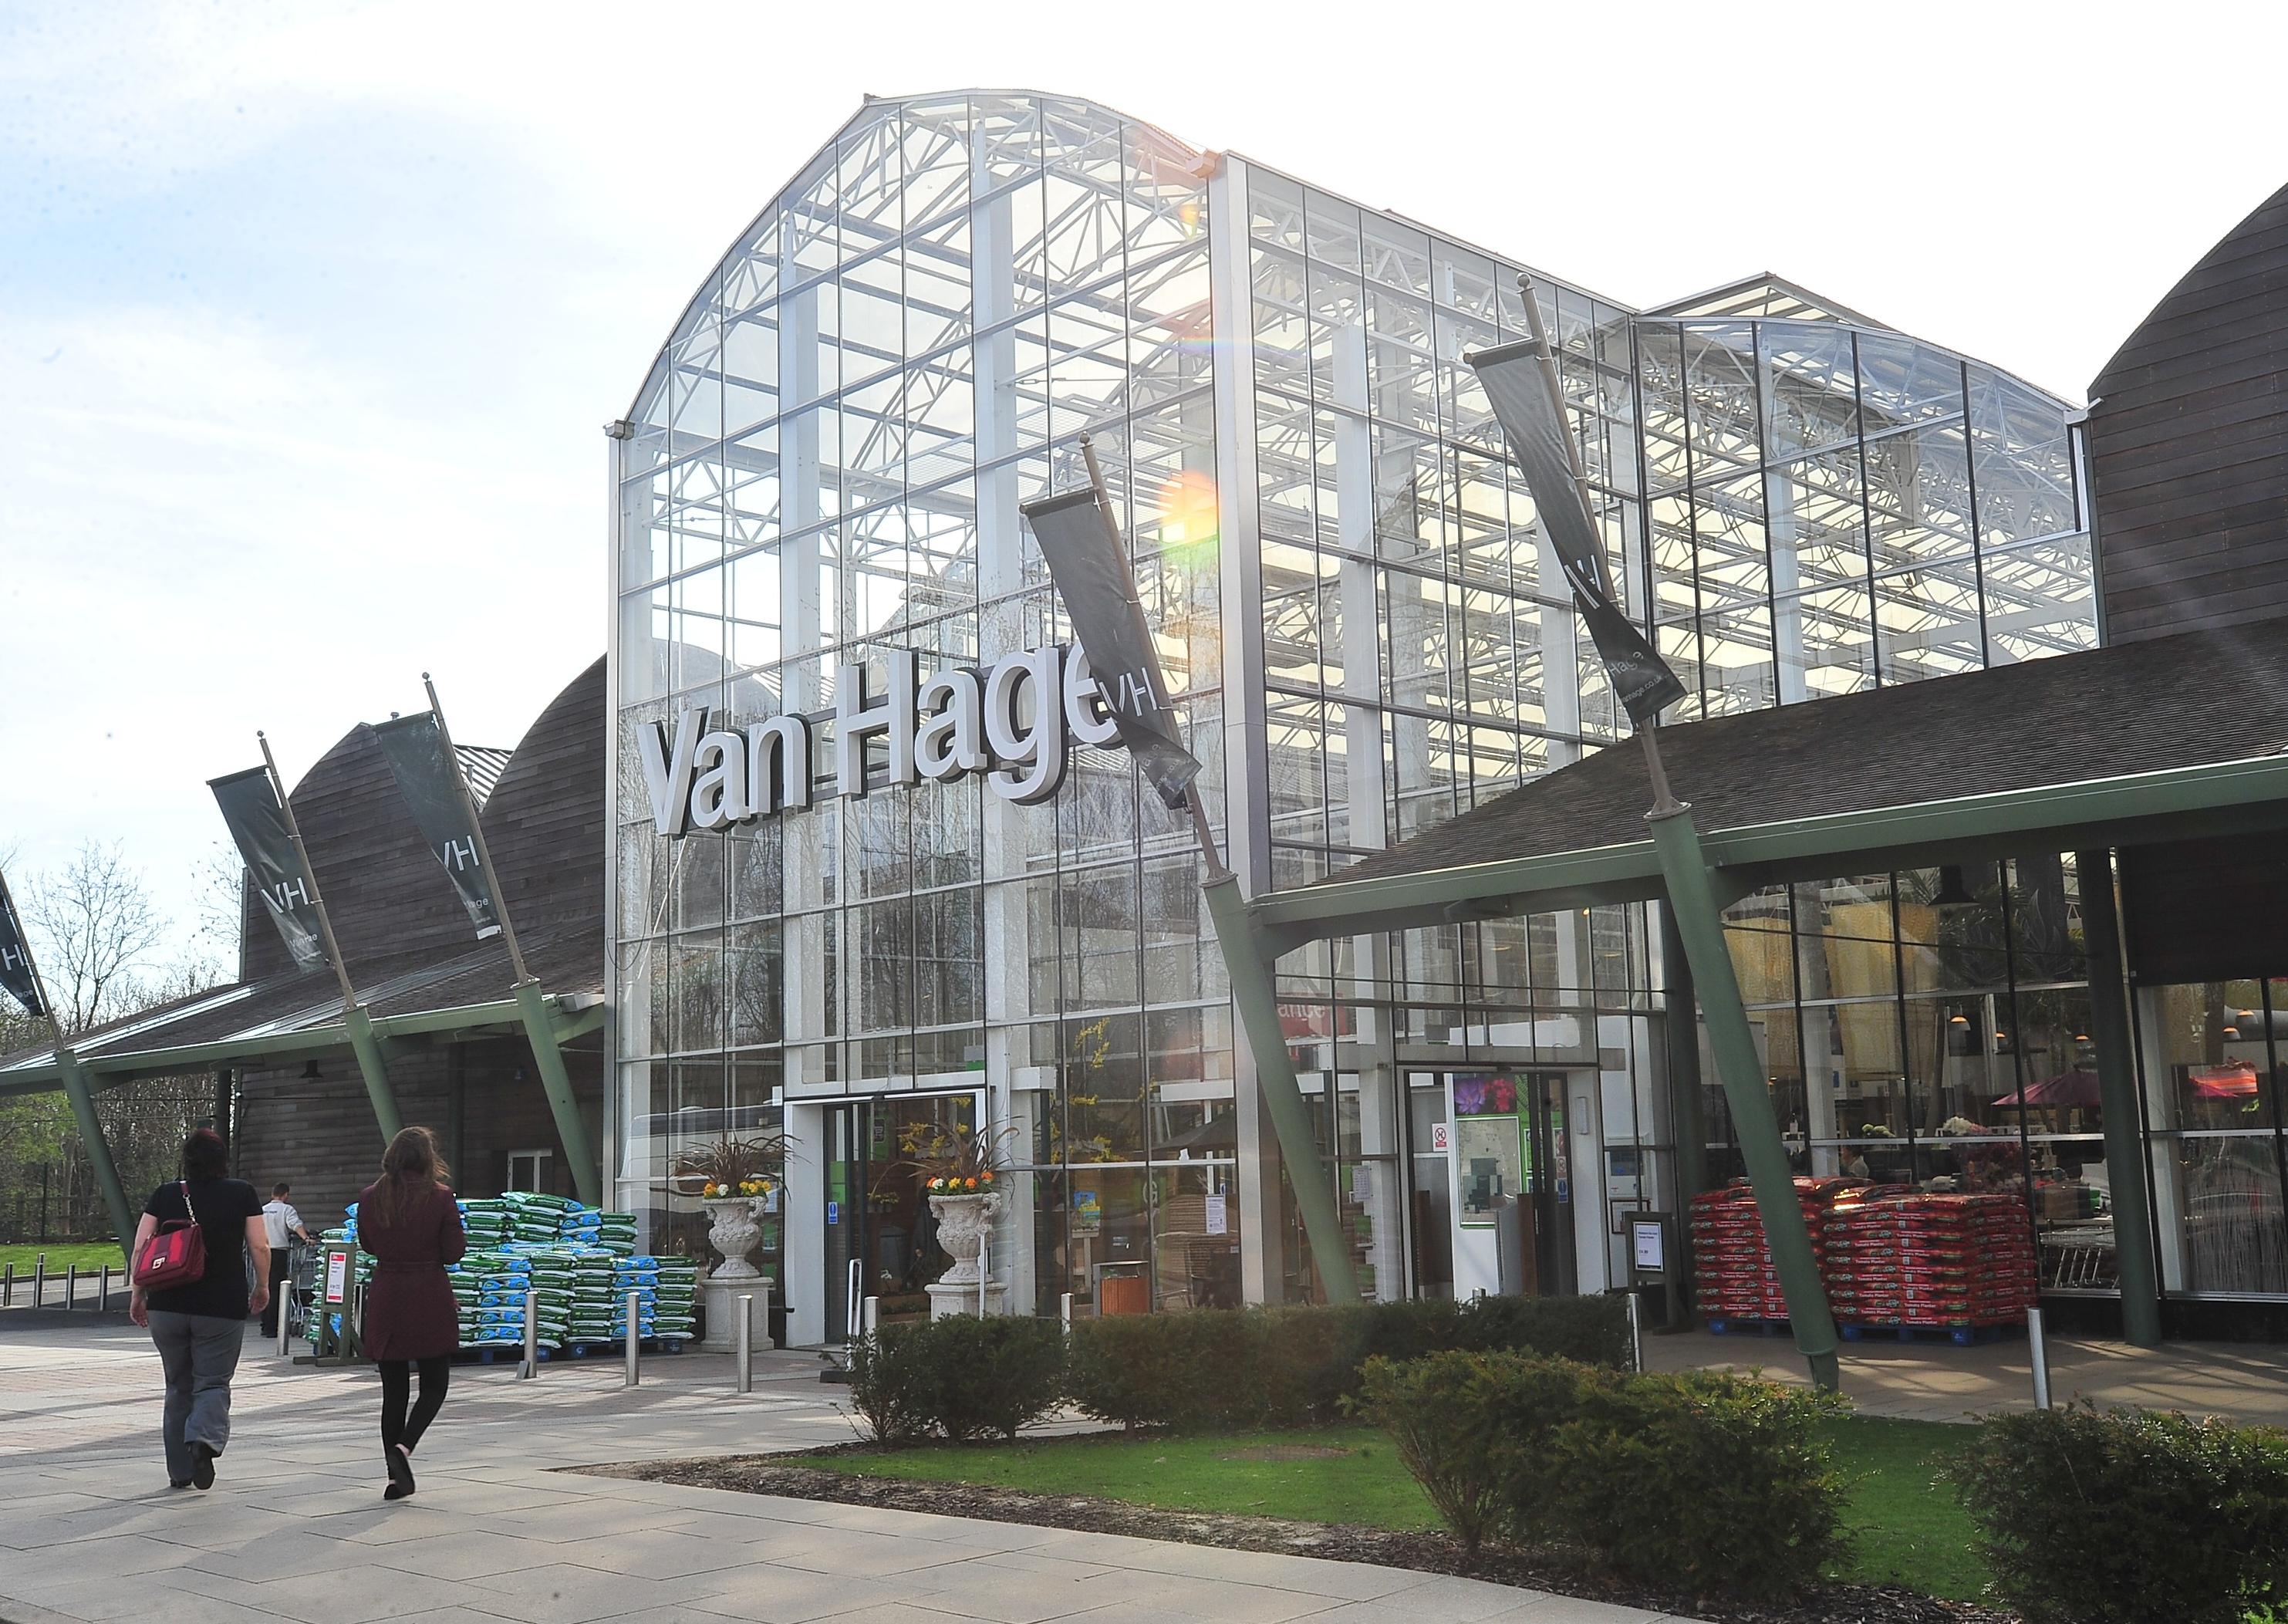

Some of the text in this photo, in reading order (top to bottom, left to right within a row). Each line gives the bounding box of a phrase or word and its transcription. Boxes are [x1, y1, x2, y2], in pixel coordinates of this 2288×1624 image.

[1098, 667, 1157, 717] VH
[636, 643, 1119, 840] Van Hage
[261, 876, 309, 913] VH
